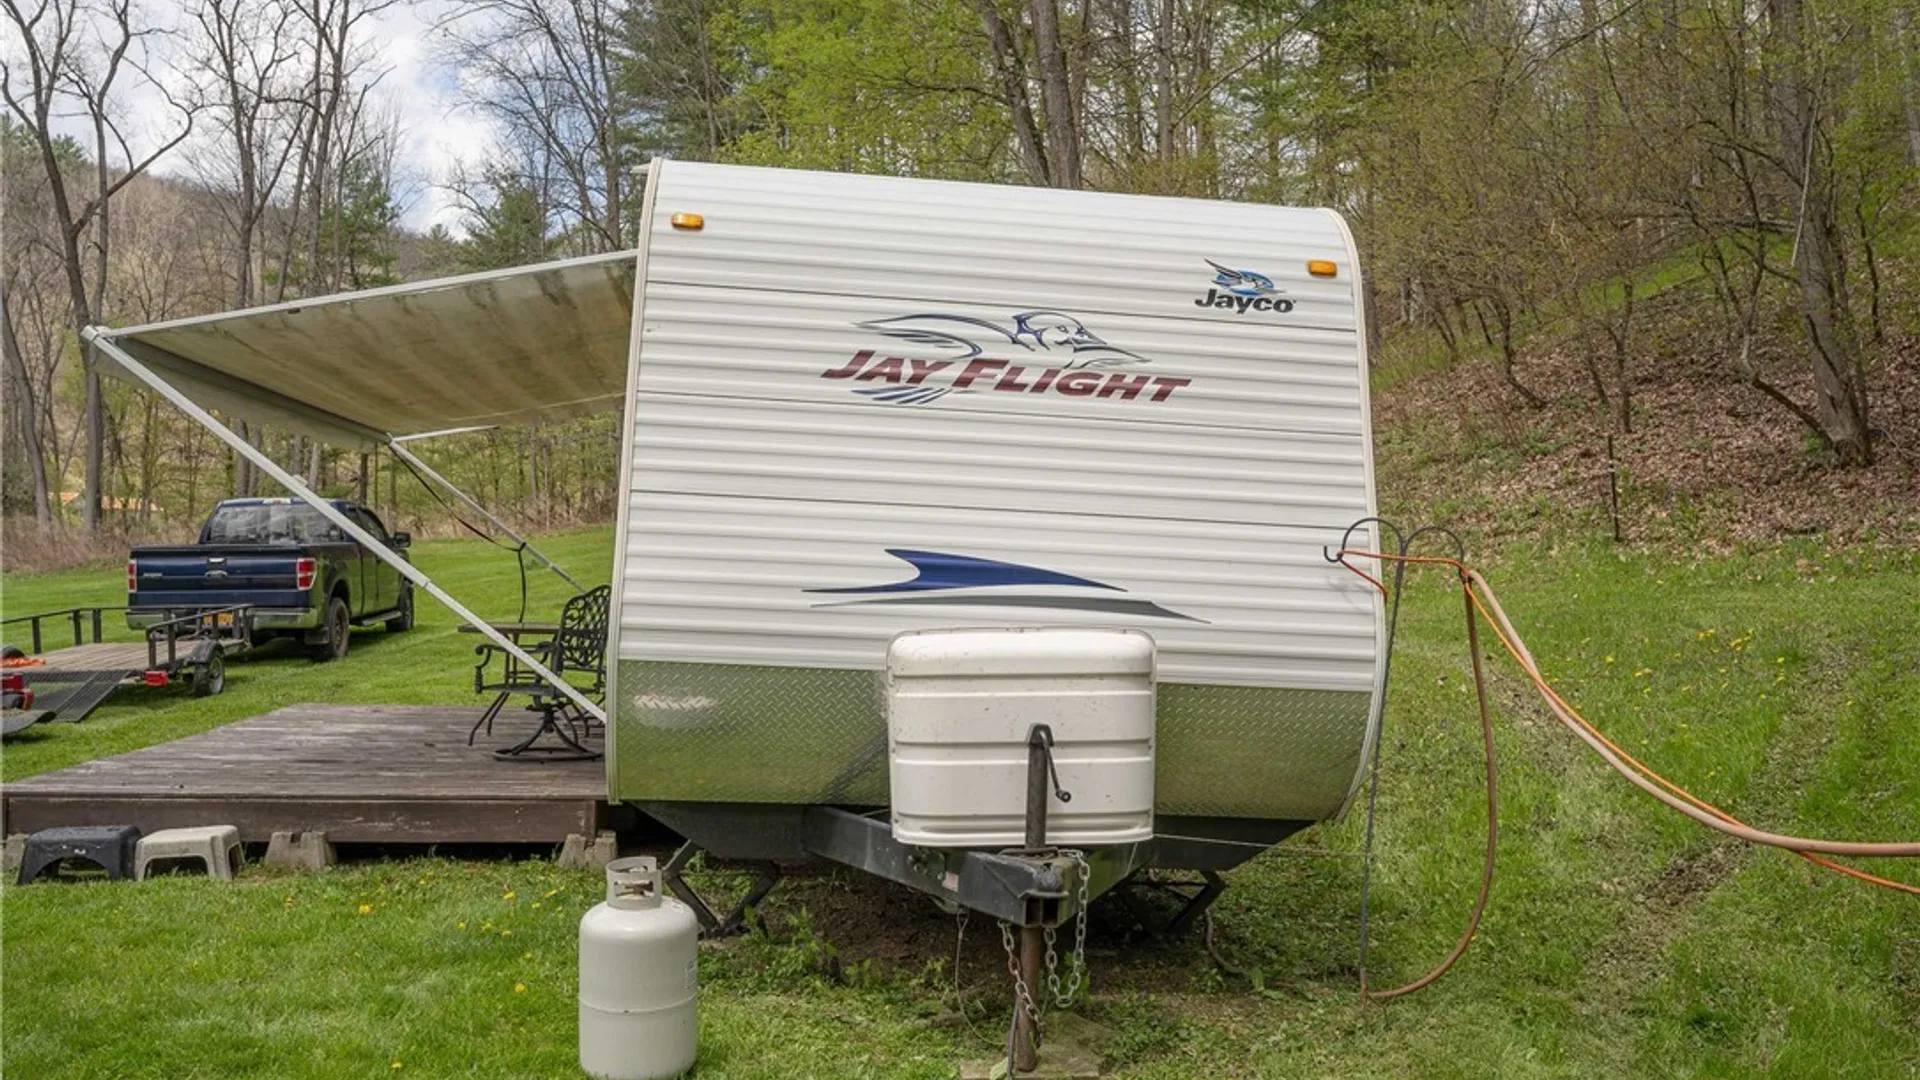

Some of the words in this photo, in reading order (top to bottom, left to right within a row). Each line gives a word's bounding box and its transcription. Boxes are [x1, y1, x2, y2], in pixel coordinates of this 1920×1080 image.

[1195, 288, 1294, 315] Jayco
[821, 350, 954, 386] JAY
[951, 358, 1192, 403] FLIGHT
